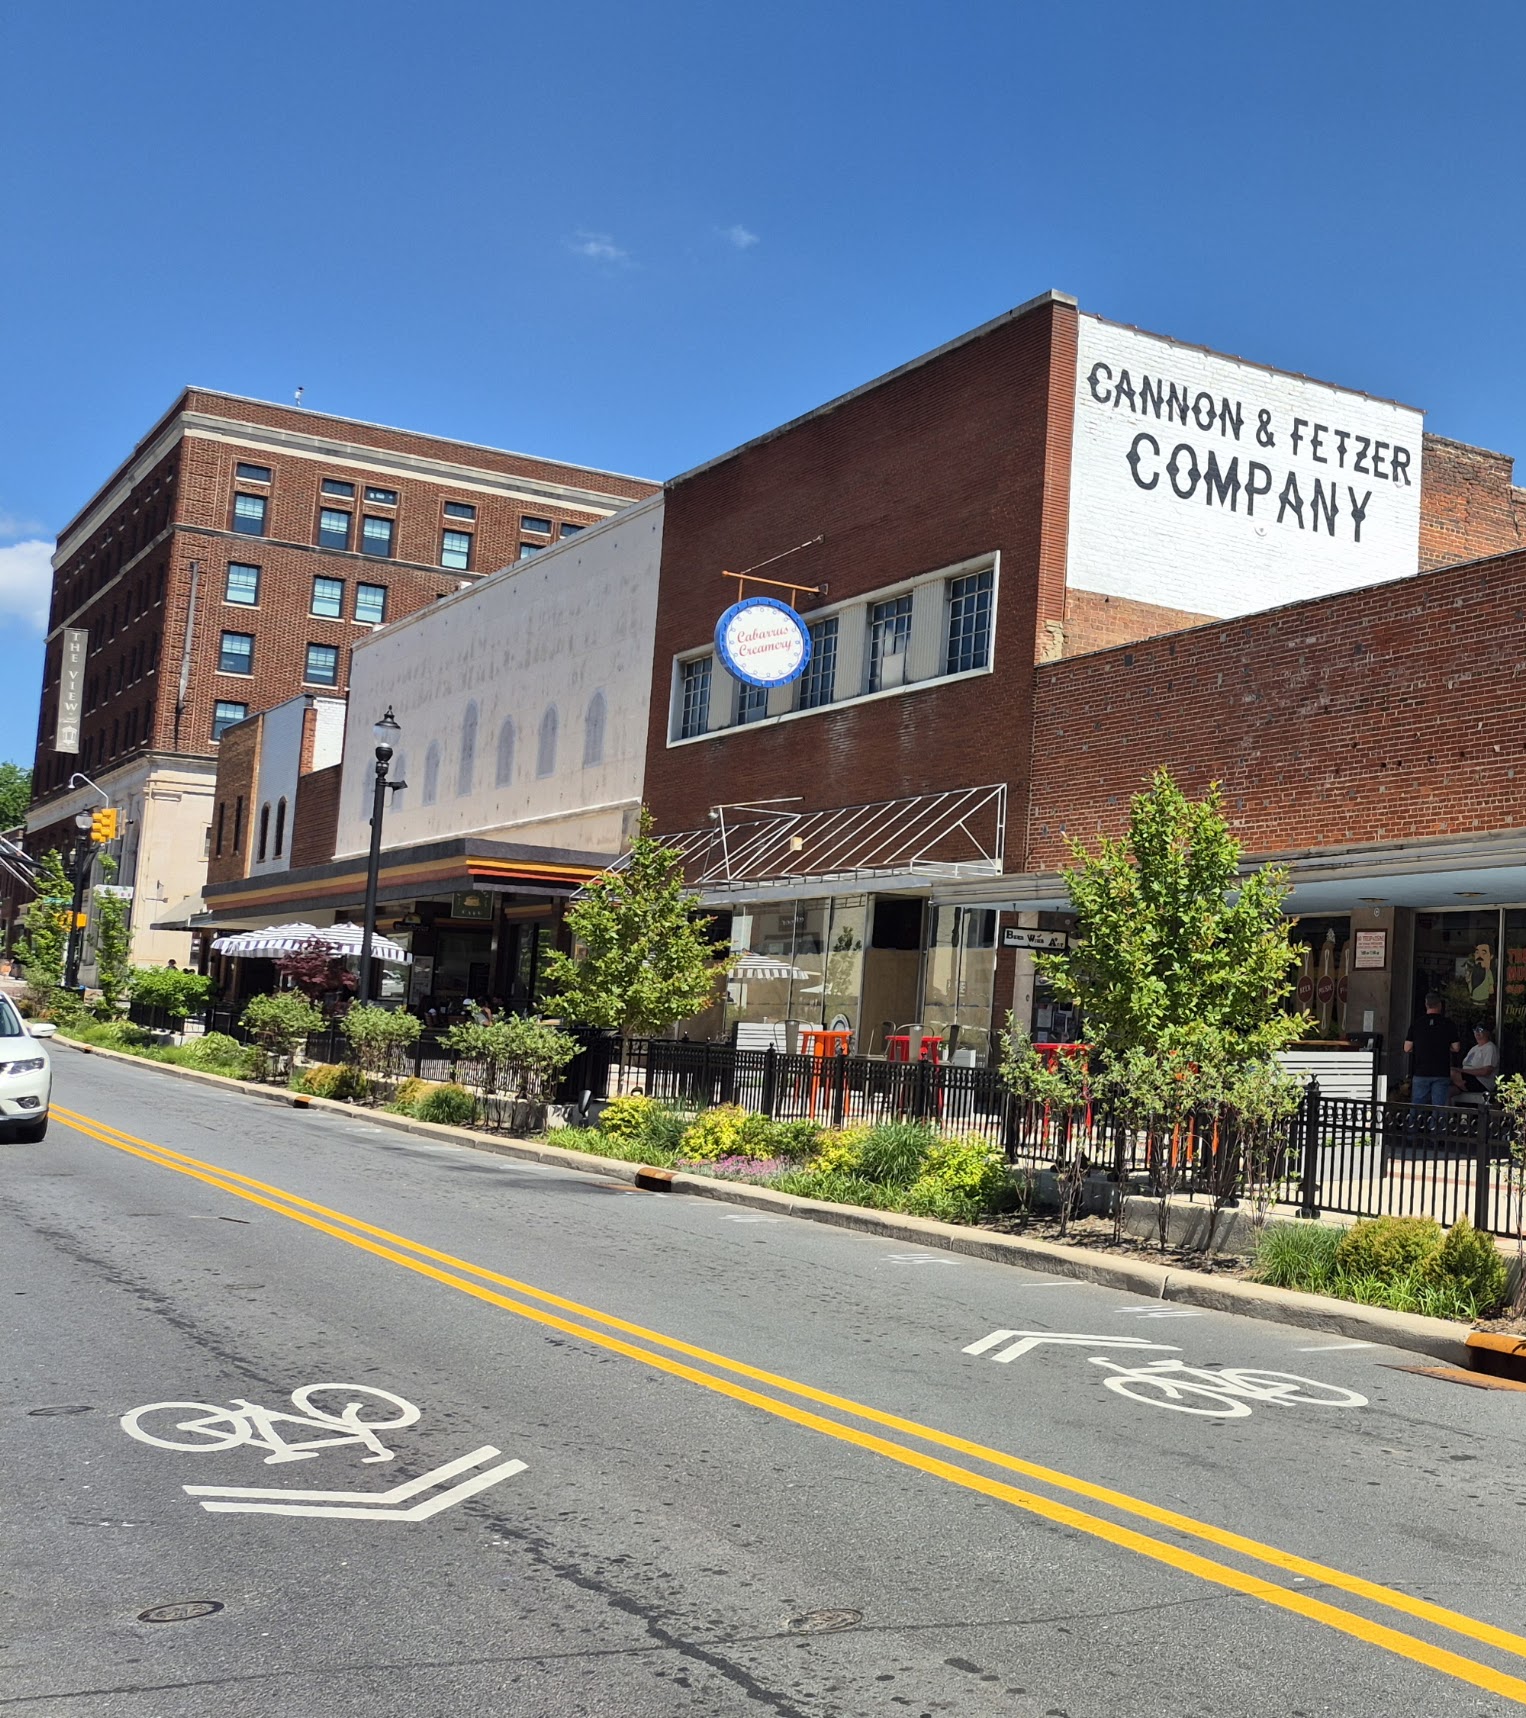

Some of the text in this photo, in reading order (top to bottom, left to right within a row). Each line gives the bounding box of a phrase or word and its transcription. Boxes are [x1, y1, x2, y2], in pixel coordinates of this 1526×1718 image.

[1087, 362, 1412, 486] CANNON & FETZER
[1125, 432, 1372, 543] COMPANY
[737, 626, 789, 644] Cabarrus
[738, 640, 793, 657] Creamery
[65, 632, 81, 711] THE VIEW
[1113, 1305, 1205, 1318] 44
